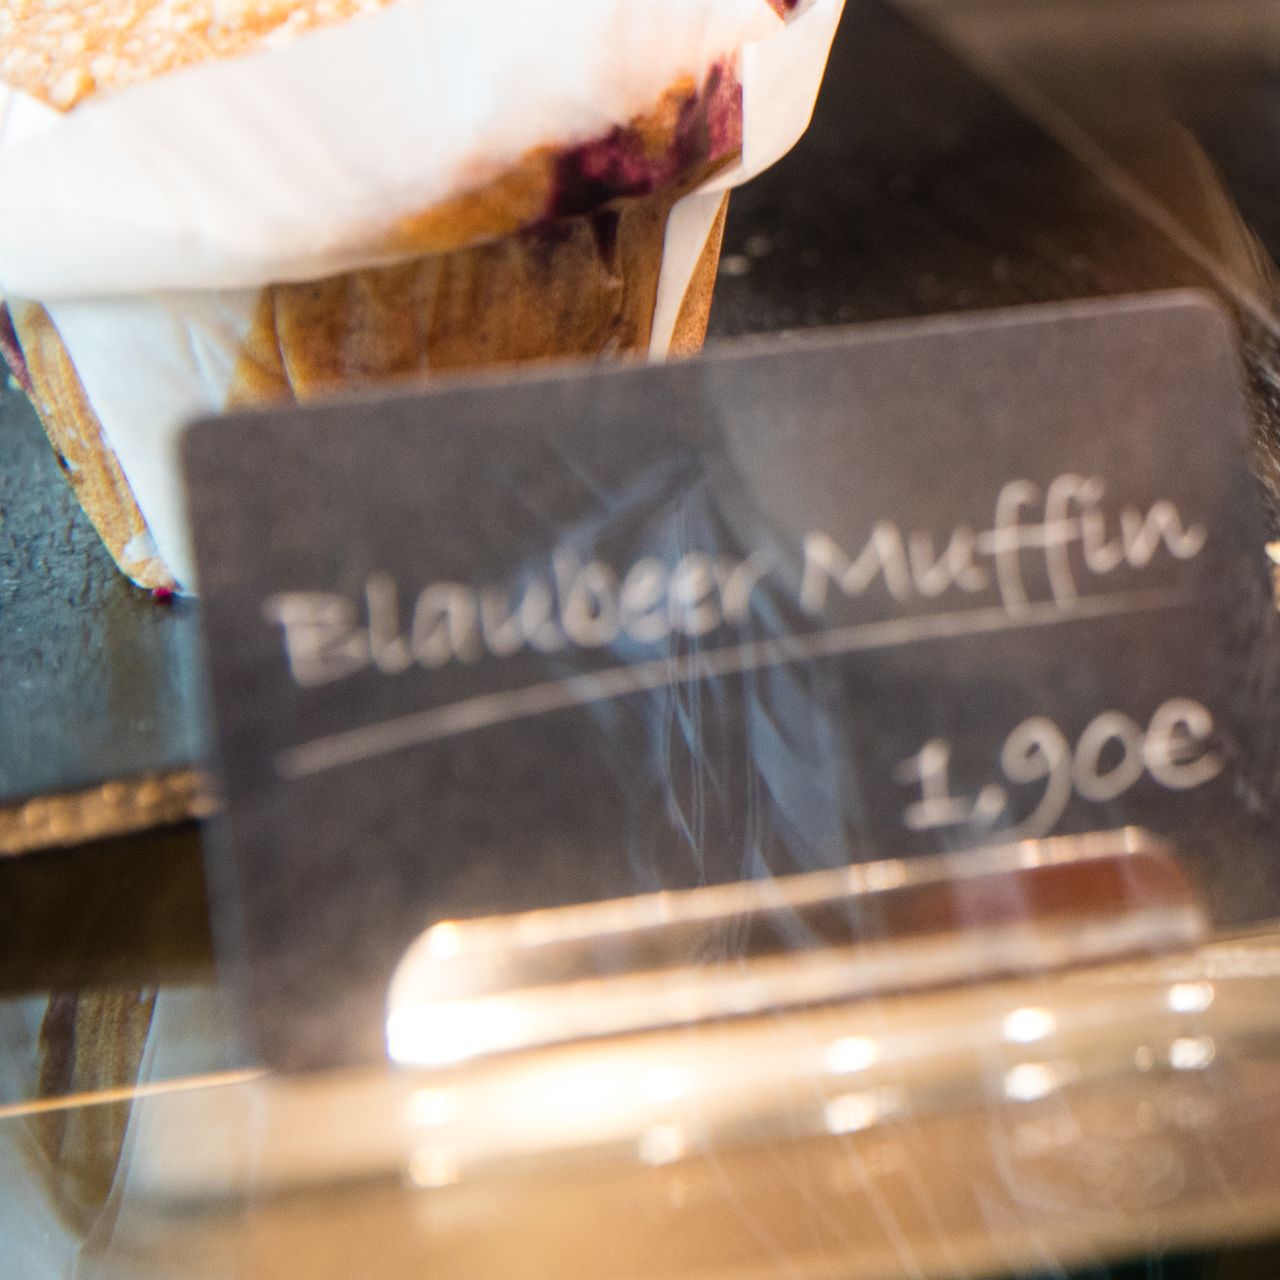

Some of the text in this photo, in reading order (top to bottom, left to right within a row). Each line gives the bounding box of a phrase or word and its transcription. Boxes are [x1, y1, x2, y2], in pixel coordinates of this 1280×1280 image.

[265, 472, 1206, 686] Blaubeer Muffin
[896, 698, 1224, 838] 1,90€
